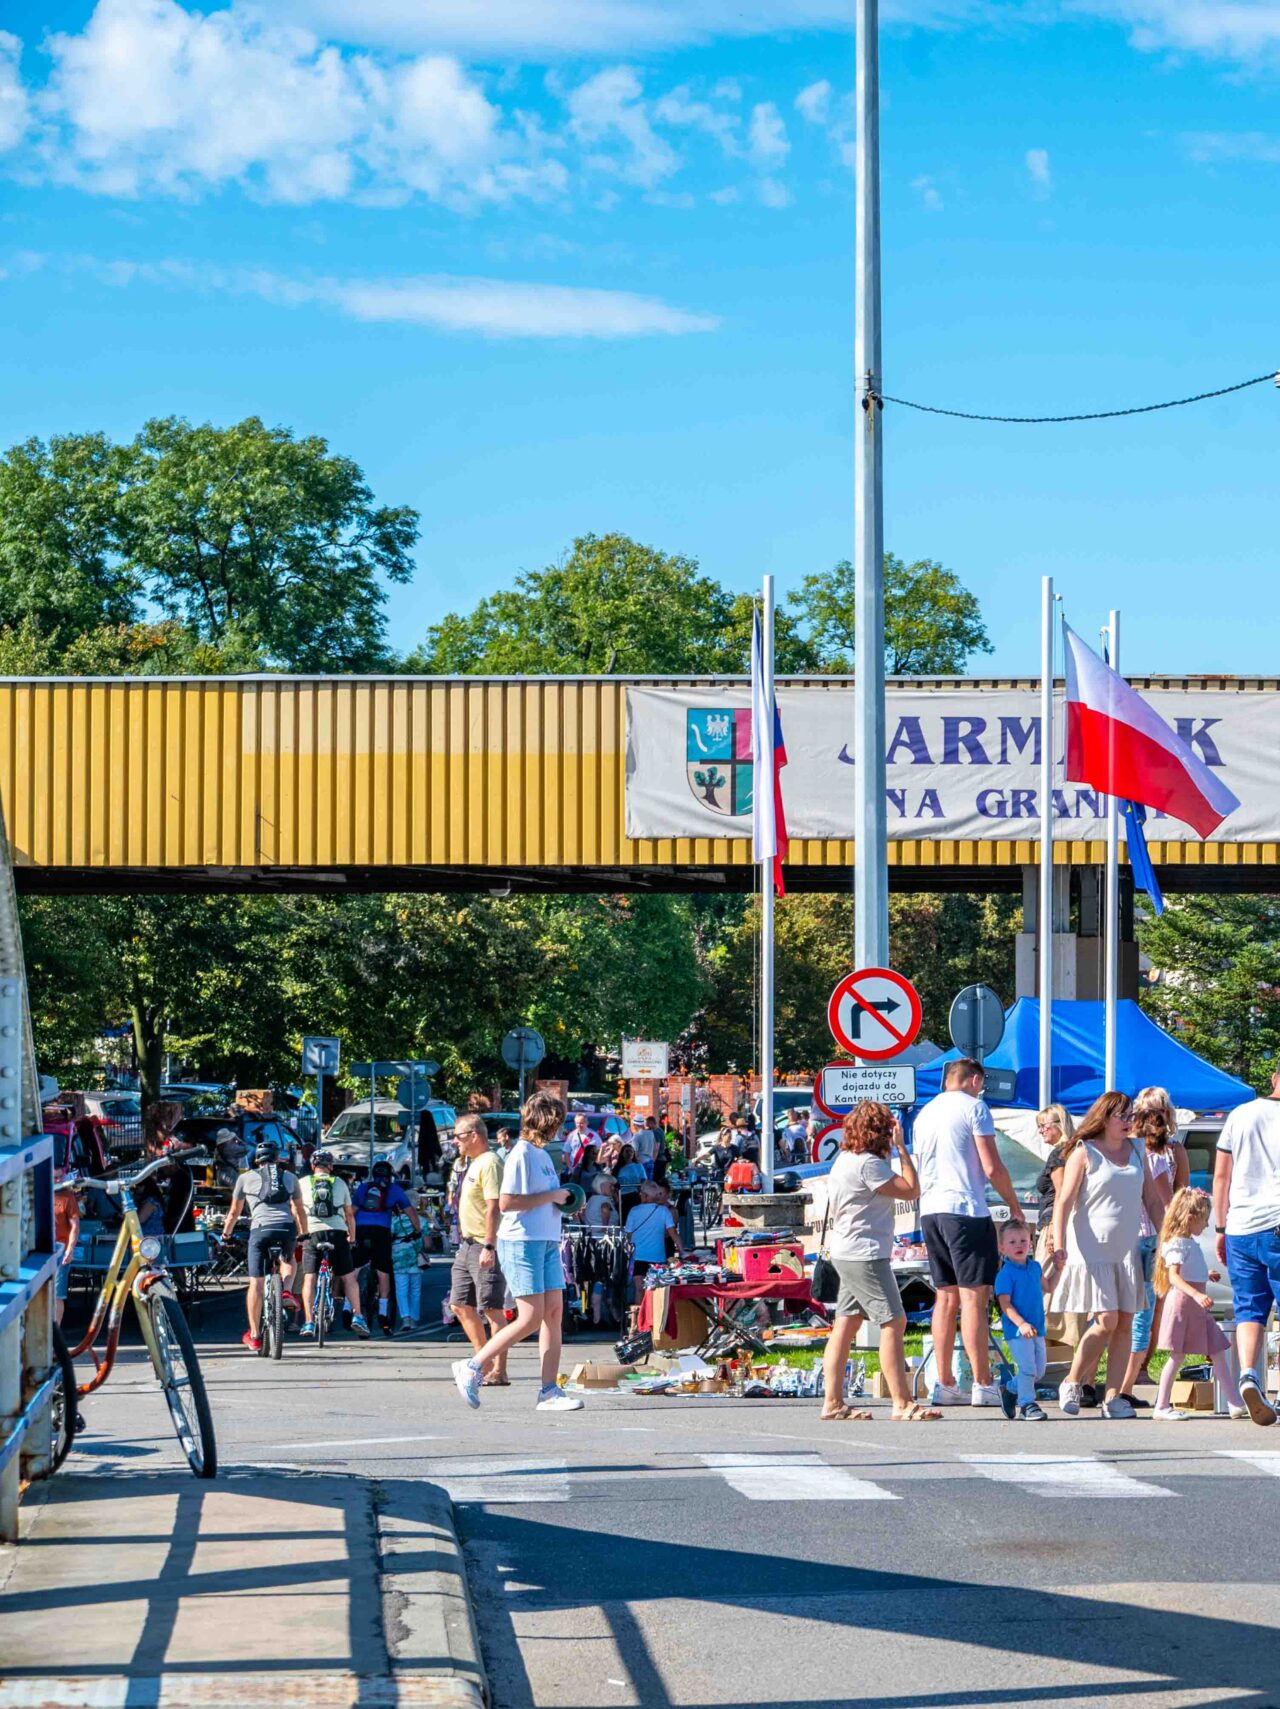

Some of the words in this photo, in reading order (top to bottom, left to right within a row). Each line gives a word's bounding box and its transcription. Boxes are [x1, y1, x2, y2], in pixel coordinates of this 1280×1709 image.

[838, 716, 1227, 767] ARMK
[841, 1070, 858, 1079] Nie
[861, 1069, 897, 1079] dotyczy
[842, 1082, 880, 1093] dojazdu
[884, 1081, 897, 1090] do
[882, 1092, 905, 1101] CGO
